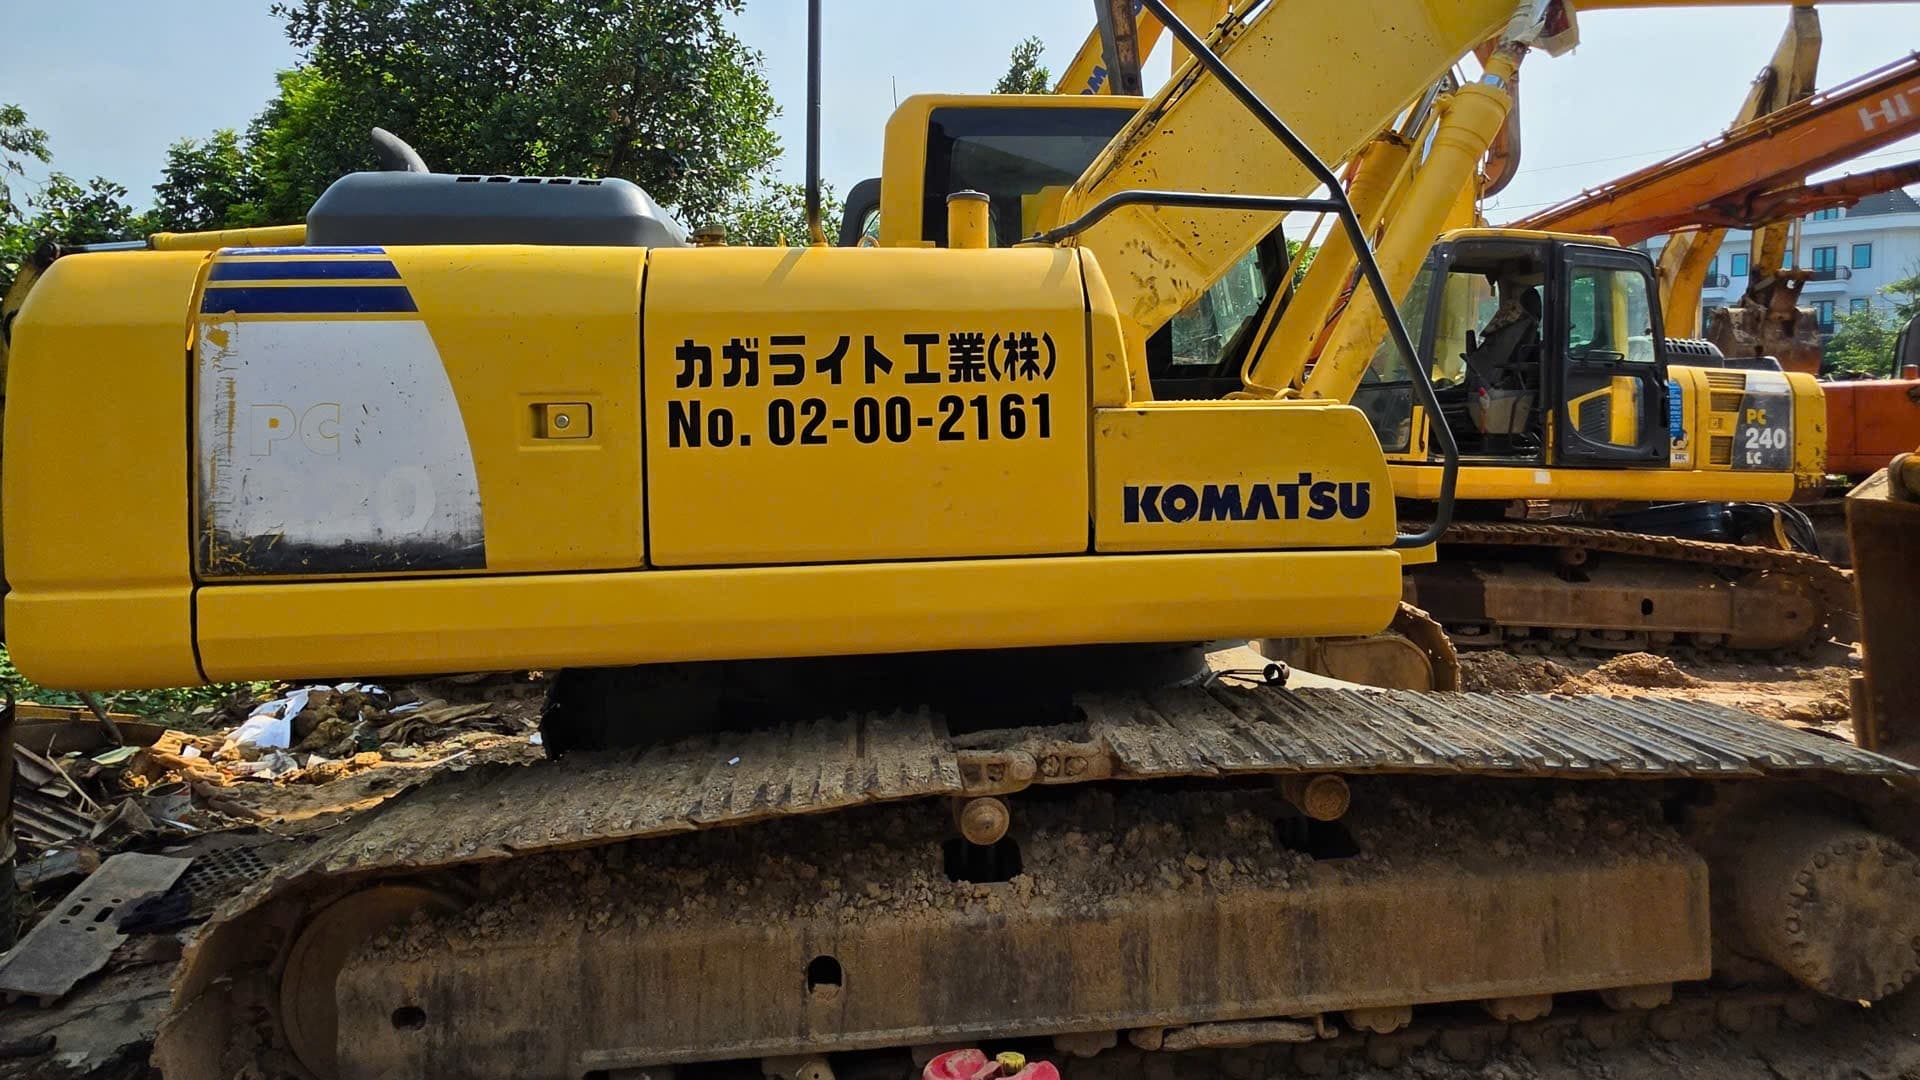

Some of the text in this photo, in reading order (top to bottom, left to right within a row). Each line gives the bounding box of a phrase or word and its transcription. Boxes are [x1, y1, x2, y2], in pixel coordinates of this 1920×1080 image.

[668, 393, 1050, 447] No. 02-00-2161
[1746, 408, 1766, 424] PC
[1745, 427, 1786, 449] 240
[1746, 451, 1762, 464] LC
[1123, 472, 1370, 523] KOMATSU
